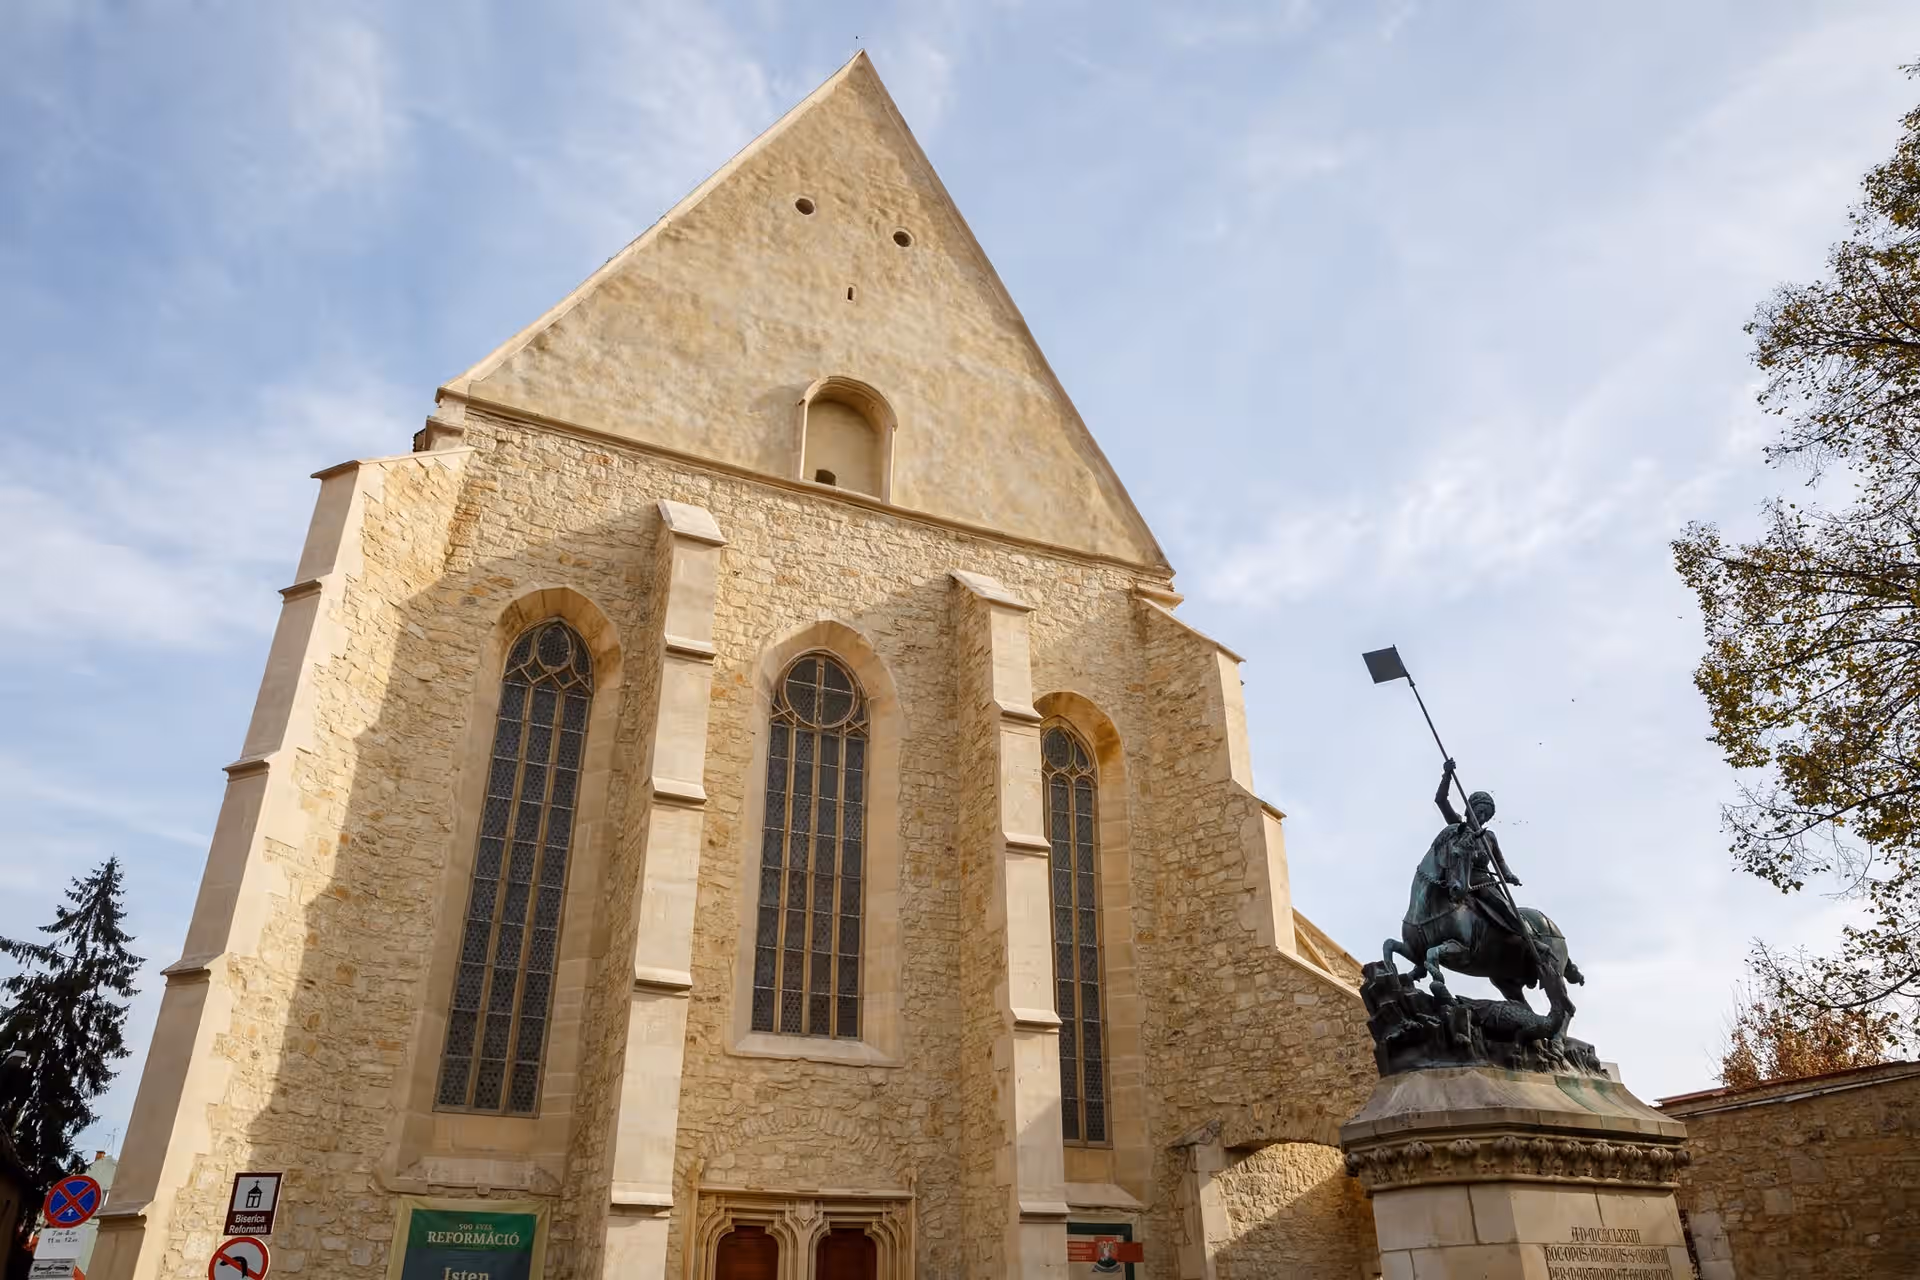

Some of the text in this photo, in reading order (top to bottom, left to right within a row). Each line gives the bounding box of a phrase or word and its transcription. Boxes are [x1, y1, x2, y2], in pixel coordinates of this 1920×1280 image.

[235, 1214, 265, 1223] Biserica
[459, 1223, 473, 1231] 500
[427, 1230, 520, 1246] REFORMÁCIÓ
[444, 1267, 490, 1280] Isten
